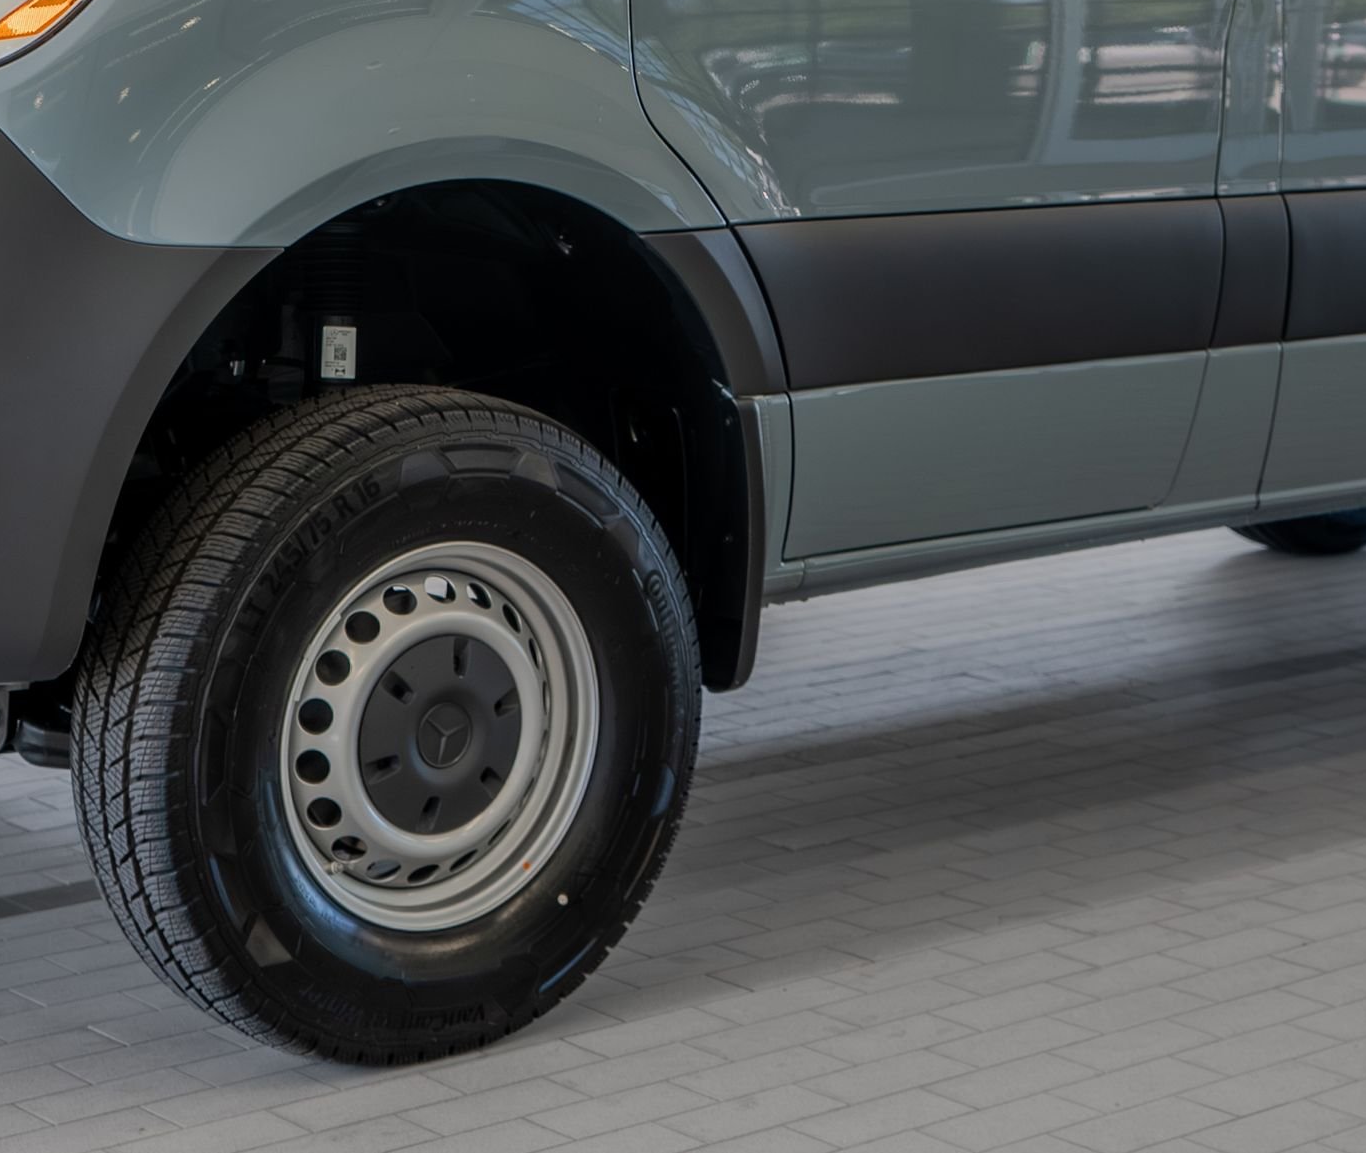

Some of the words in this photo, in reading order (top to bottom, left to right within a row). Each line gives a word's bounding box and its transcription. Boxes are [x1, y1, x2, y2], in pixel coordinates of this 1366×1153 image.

[259, 511, 333, 596] 245/75
[331, 494, 356, 520] R
[351, 473, 382, 506] 16
